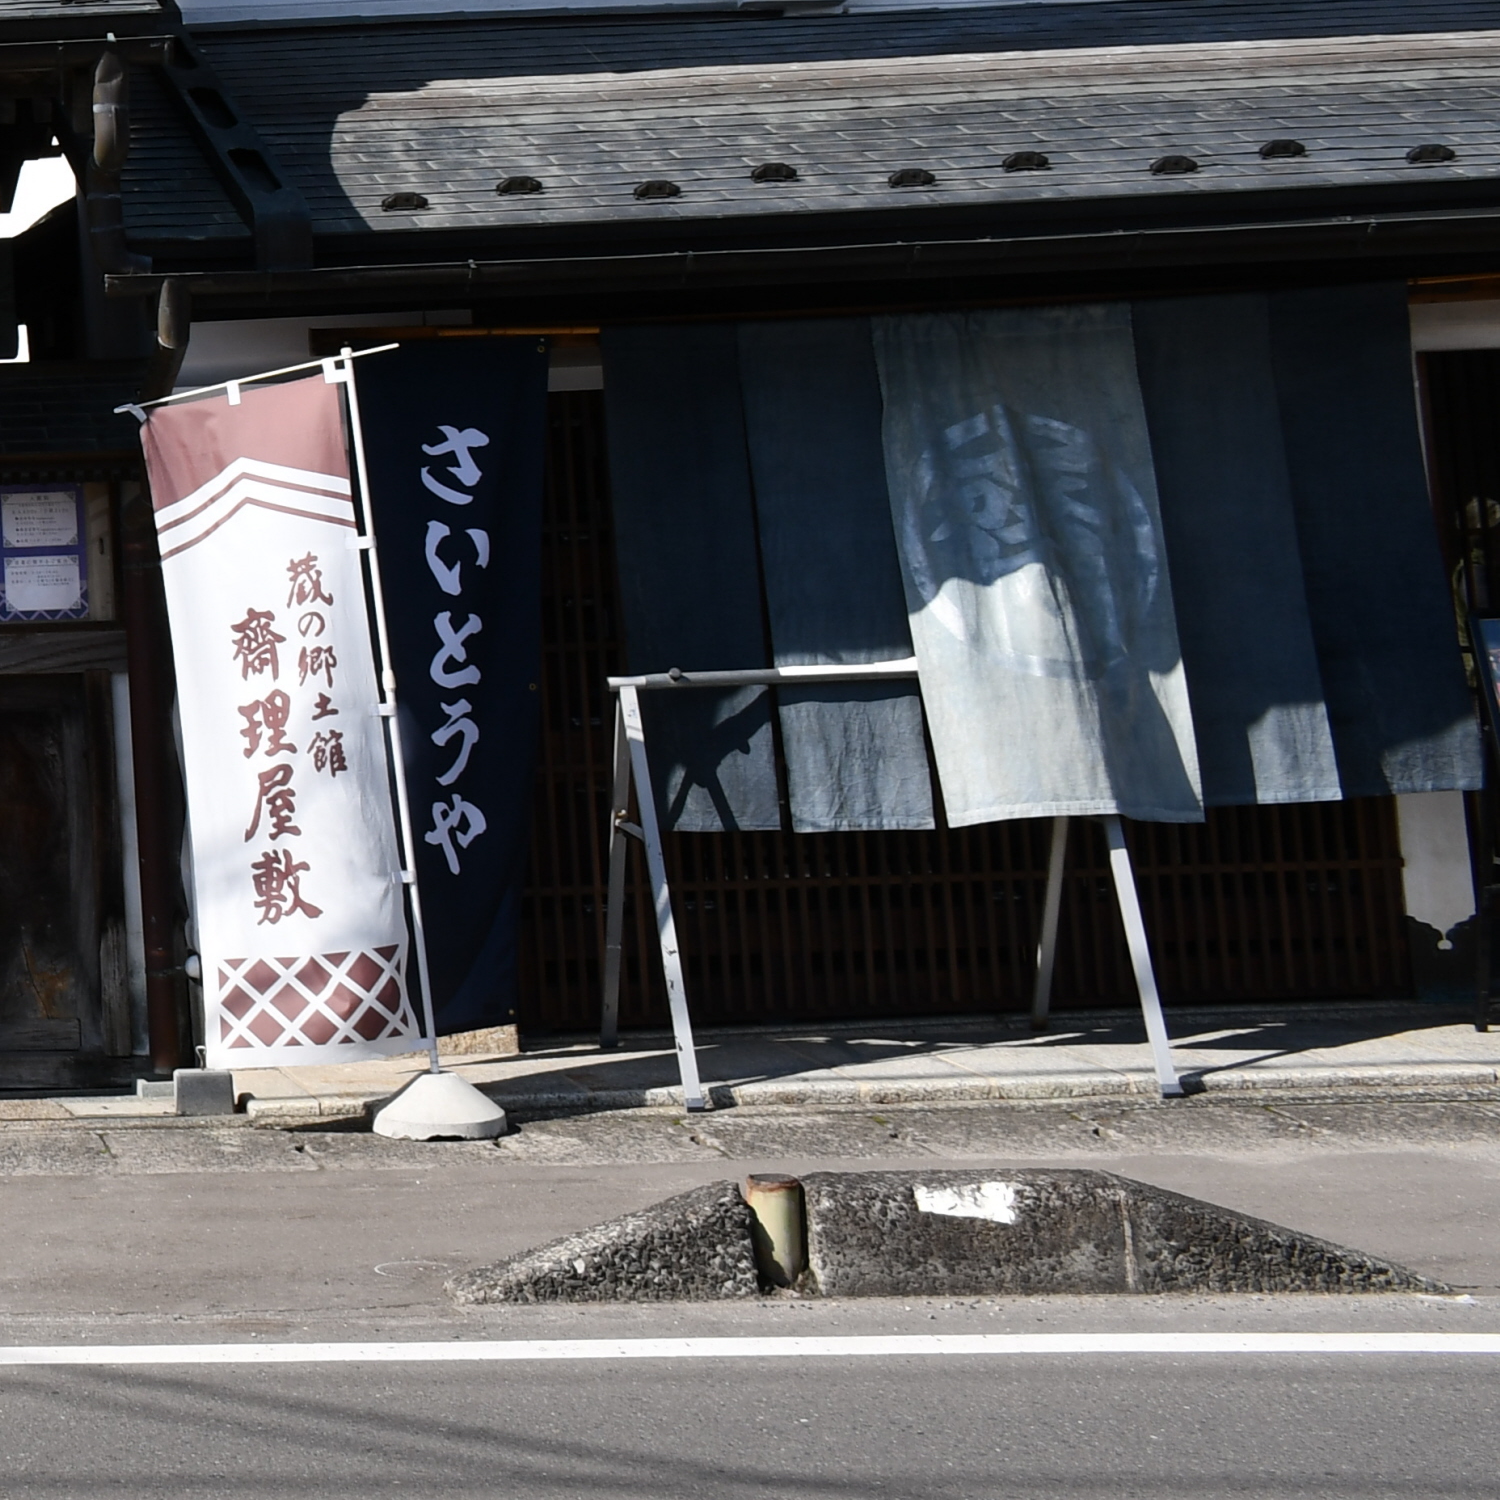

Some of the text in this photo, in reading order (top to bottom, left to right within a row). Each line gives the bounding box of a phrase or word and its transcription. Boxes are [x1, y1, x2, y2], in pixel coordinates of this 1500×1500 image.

[230, 607, 325, 926] 齋理屋敷
[286, 551, 348, 778] 蔵の郷土館
[419, 423, 491, 877] さいとうや
